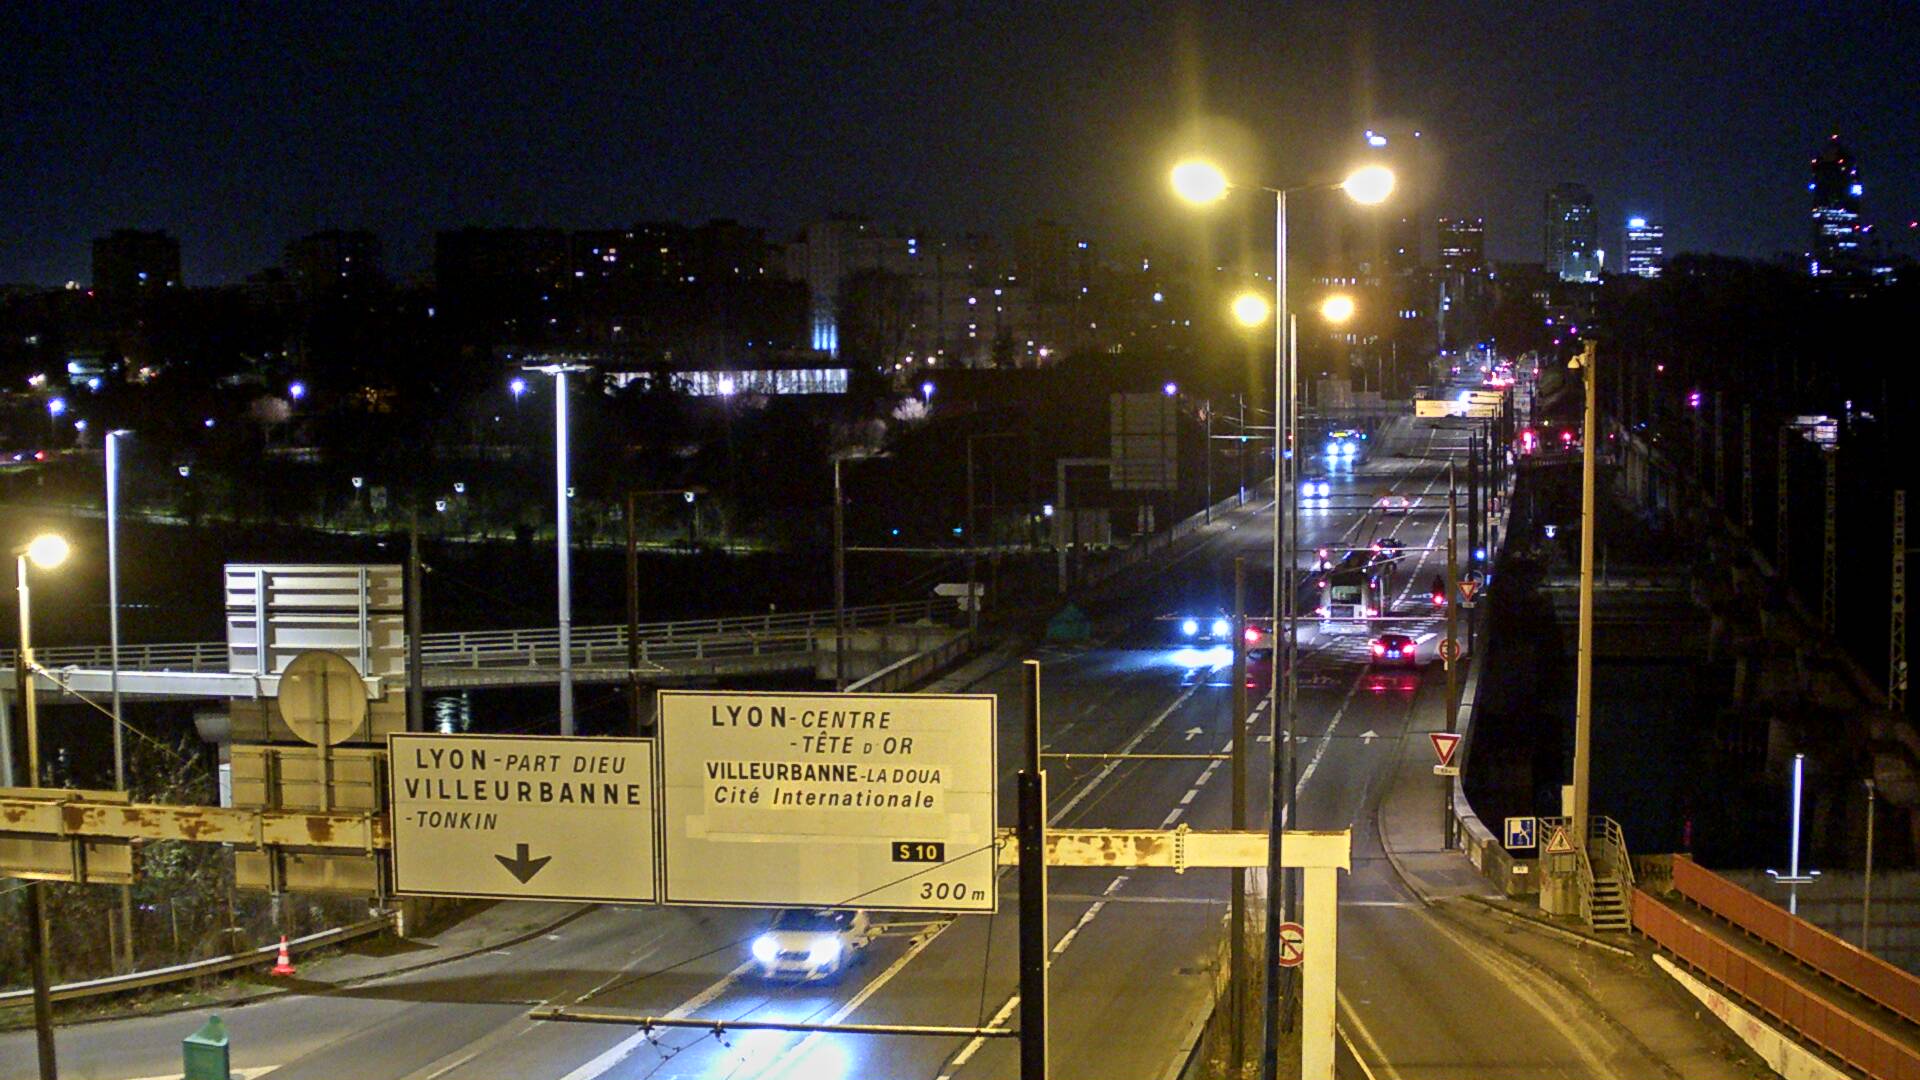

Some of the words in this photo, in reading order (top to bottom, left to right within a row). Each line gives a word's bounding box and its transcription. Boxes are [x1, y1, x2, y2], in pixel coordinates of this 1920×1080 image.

[572, 755, 626, 775] DIEU
[892, 768, 941, 784] DOUA
[404, 777, 641, 806] VILLEURBANNE
[714, 785, 760, 804] Cité
[773, 787, 934, 809] Internationale
[919, 882, 967, 901] 300
